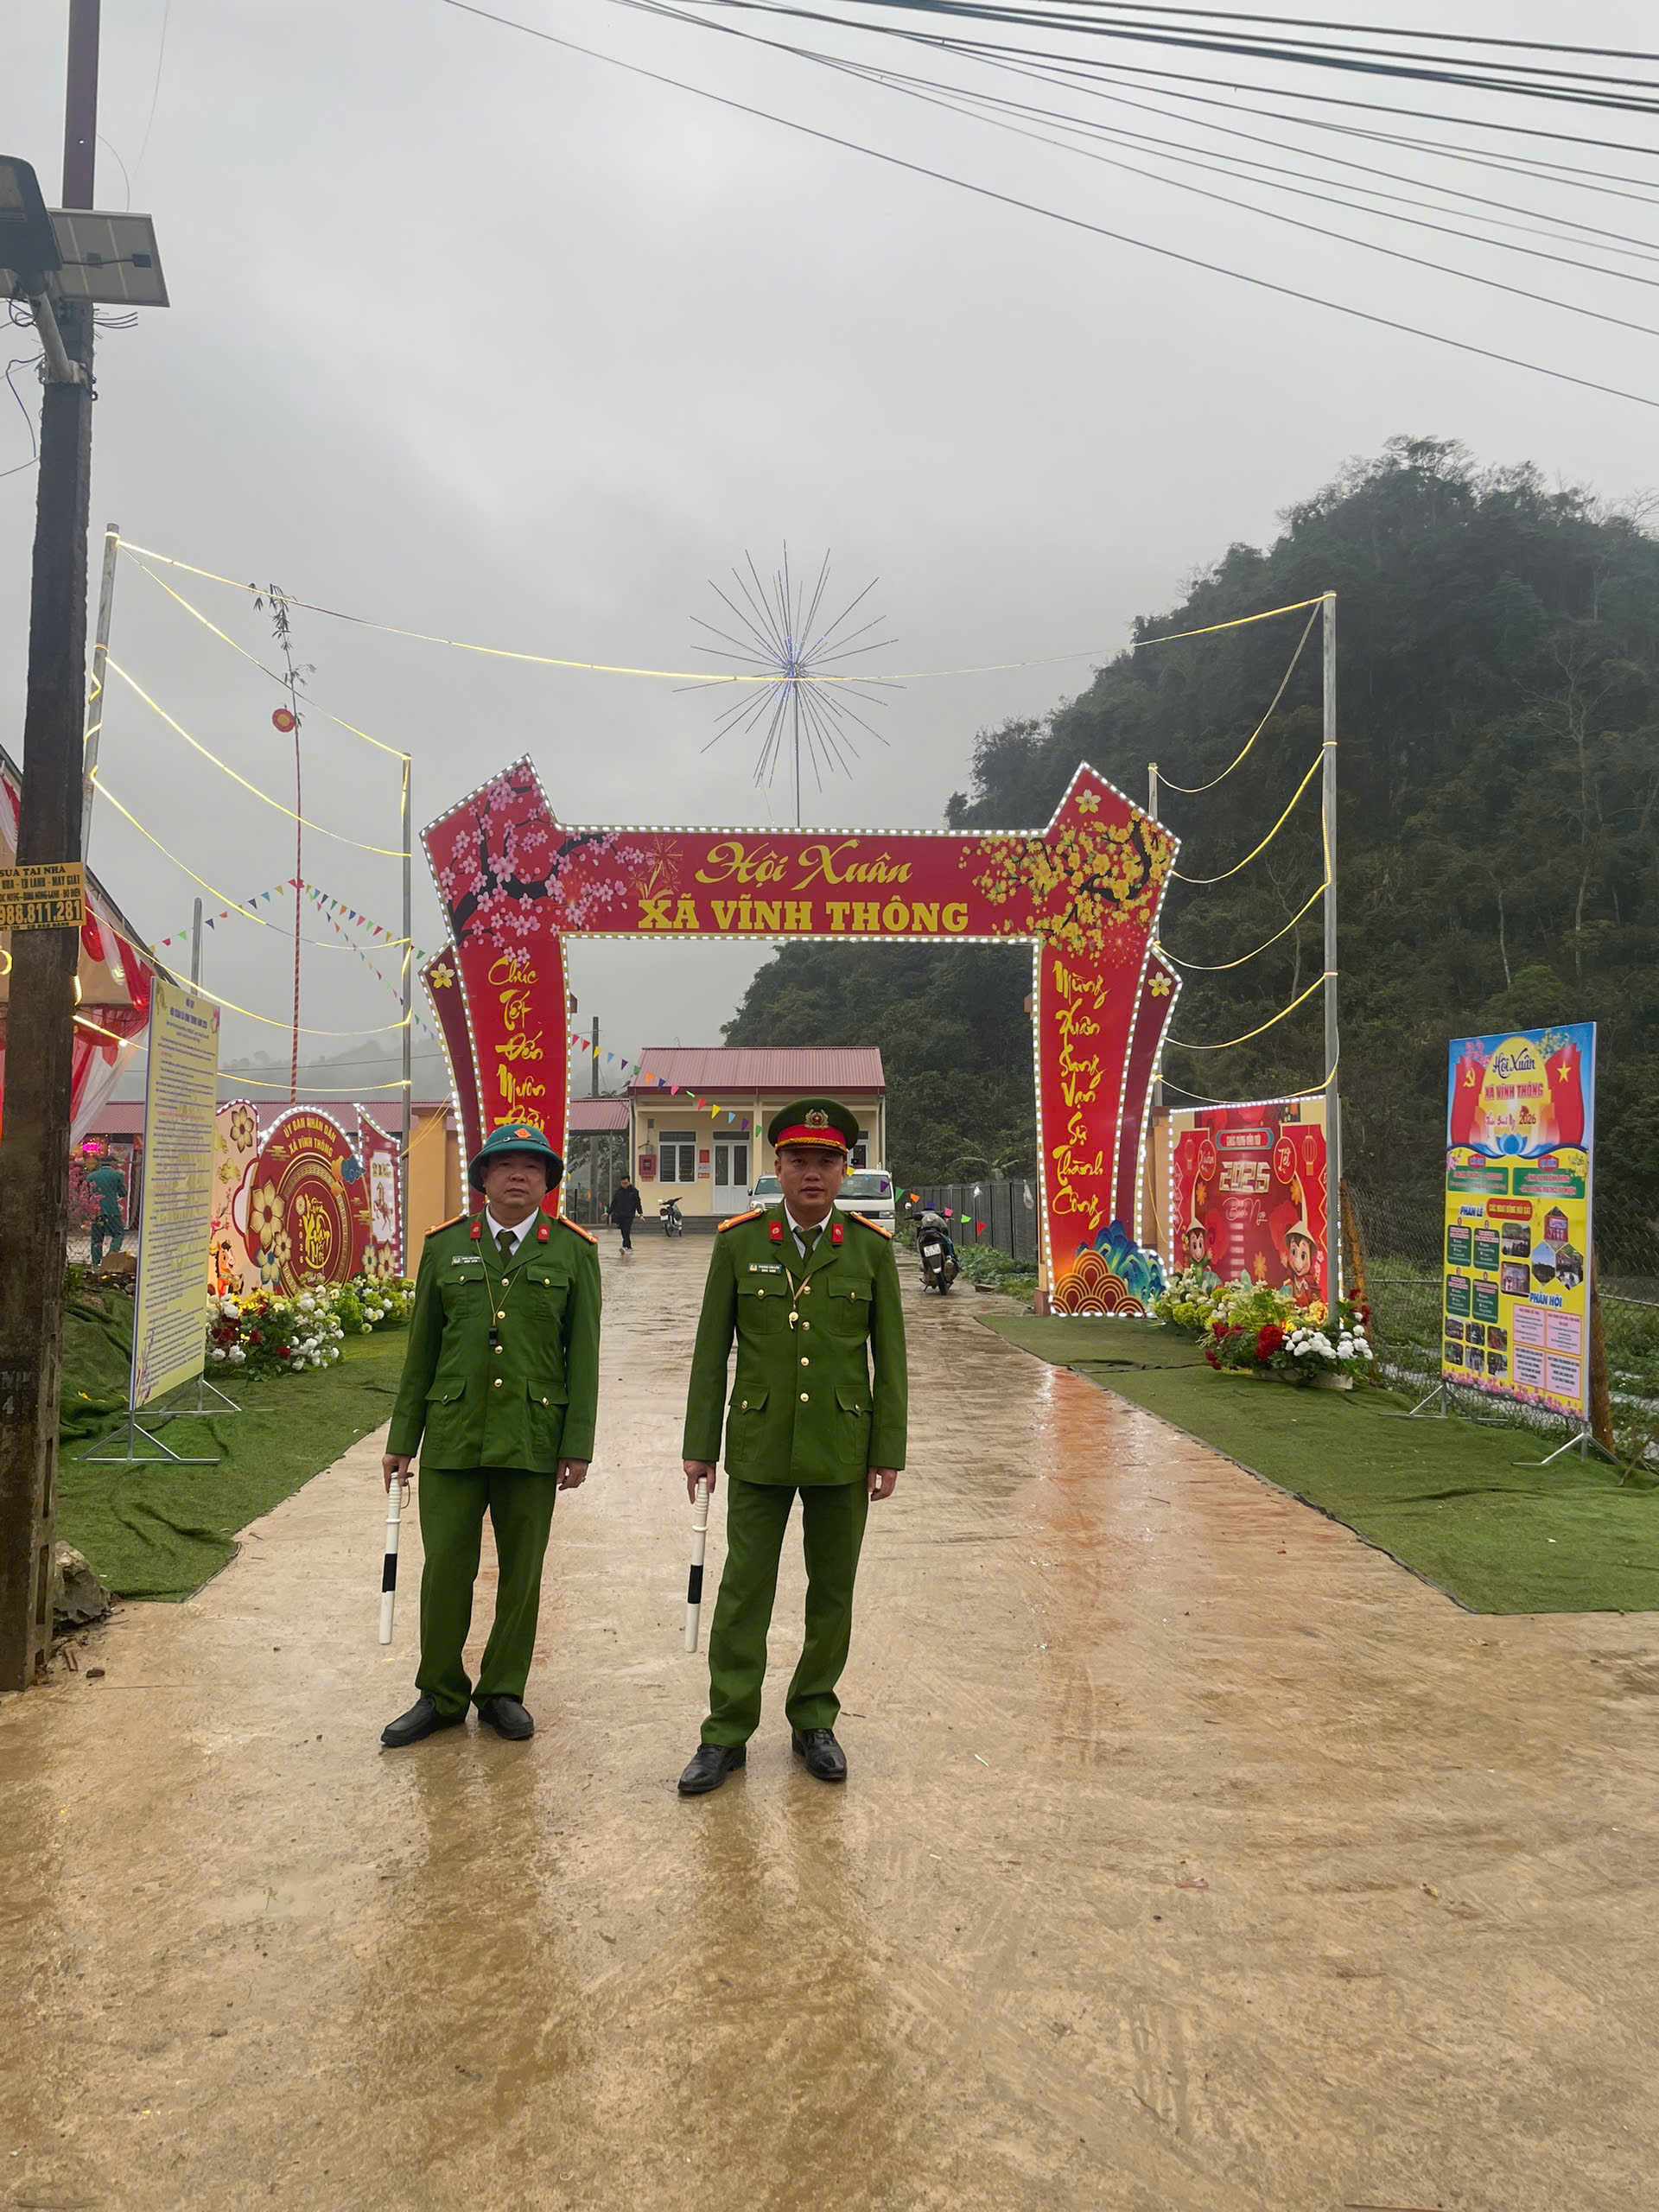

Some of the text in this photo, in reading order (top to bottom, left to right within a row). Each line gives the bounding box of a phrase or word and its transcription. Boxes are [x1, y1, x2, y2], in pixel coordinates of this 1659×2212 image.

[695, 838, 913, 891] Hội Xuân
[638, 893, 969, 932] XÃ VĨNH THÔNG
[487, 956, 540, 986] Chúc
[1052, 960, 1112, 1009] Mừng
[499, 988, 533, 1031] Tết
[1055, 998, 1100, 1049] Xuân
[495, 1030, 543, 1061] Đến
[1492, 1047, 1535, 1078] Hội Xuân
[496, 1064, 545, 1109] Muôn
[1059, 1044, 1107, 1090] Sang
[1061, 1071, 1096, 1109] Vạn
[1496, 1083, 1515, 1099] VĨNH
[1516, 1081, 1543, 1098] THÔNG
[1067, 1111, 1087, 1146] Sự
[1052, 1145, 1103, 1186] Thành
[1218, 1161, 1271, 1193] 2025
[1052, 1185, 1106, 1230] Công
[1530, 1290, 1562, 1309] PHẦN HỘI
